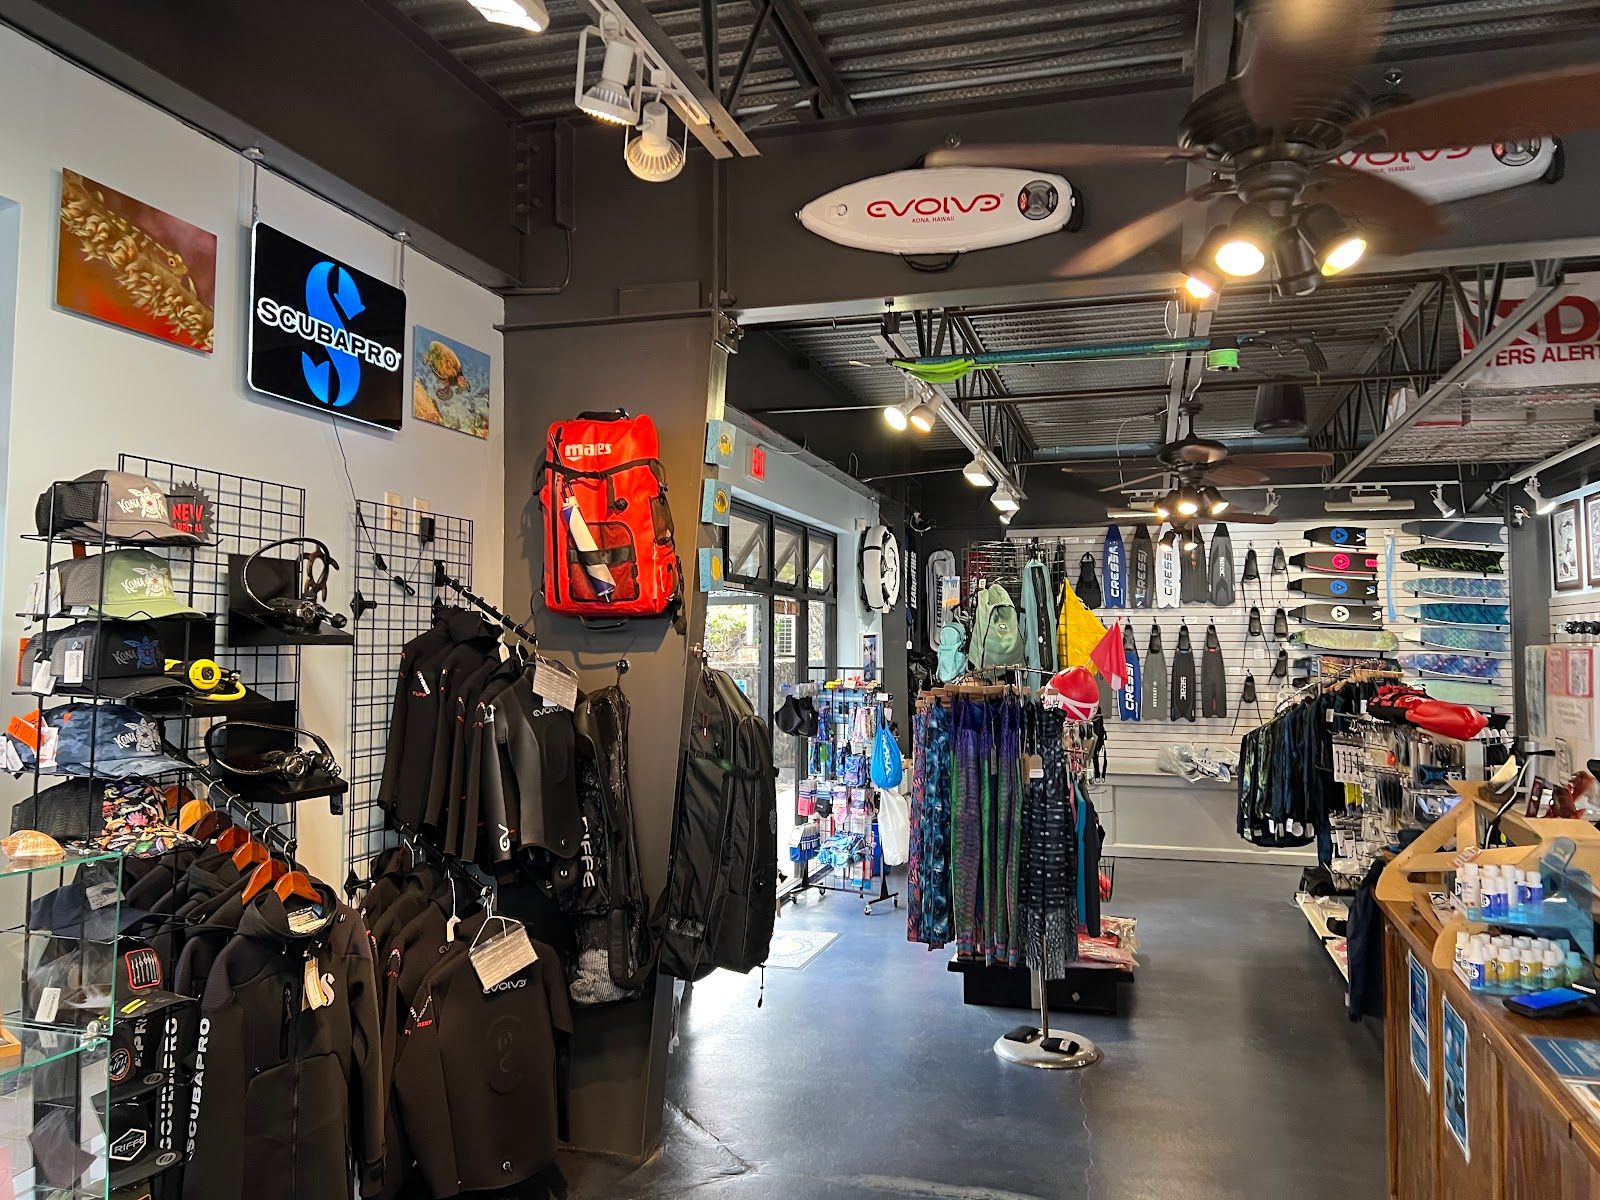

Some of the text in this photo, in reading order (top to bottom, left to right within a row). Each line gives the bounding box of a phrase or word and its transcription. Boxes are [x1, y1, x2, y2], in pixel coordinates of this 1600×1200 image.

[932, 215, 955, 223] HAWAII
[256, 296, 402, 372] SCUBAPRO
[1486, 347, 1536, 367] ERS
[564, 442, 613, 458] maes
[116, 498, 142, 514] KONA
[171, 503, 204, 521] NEW
[172, 522, 204, 533] ARRIAL
[121, 578, 145, 594] KONA
[112, 649, 137, 665] KONA
[113, 731, 137, 749] KONA
[187, 1016, 211, 1154] SCUBAPRO
[113, 1135, 145, 1155] RIFFE
